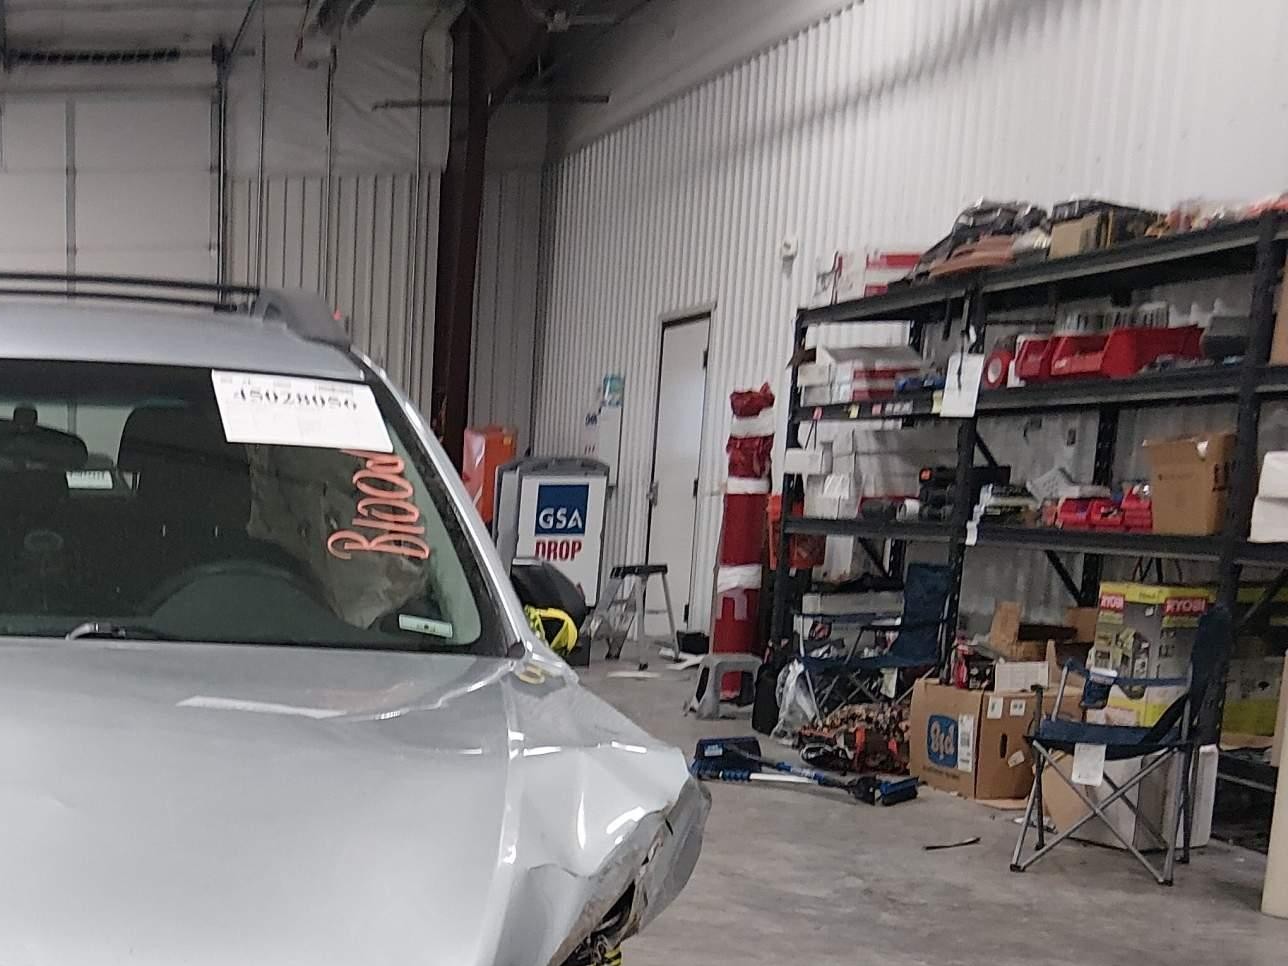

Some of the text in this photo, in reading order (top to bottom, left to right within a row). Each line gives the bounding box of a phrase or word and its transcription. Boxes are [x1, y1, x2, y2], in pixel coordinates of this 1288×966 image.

[538, 506, 583, 529] GSA
[534, 540, 582, 562] DROP
[1165, 599, 1206, 612] RYOBI
